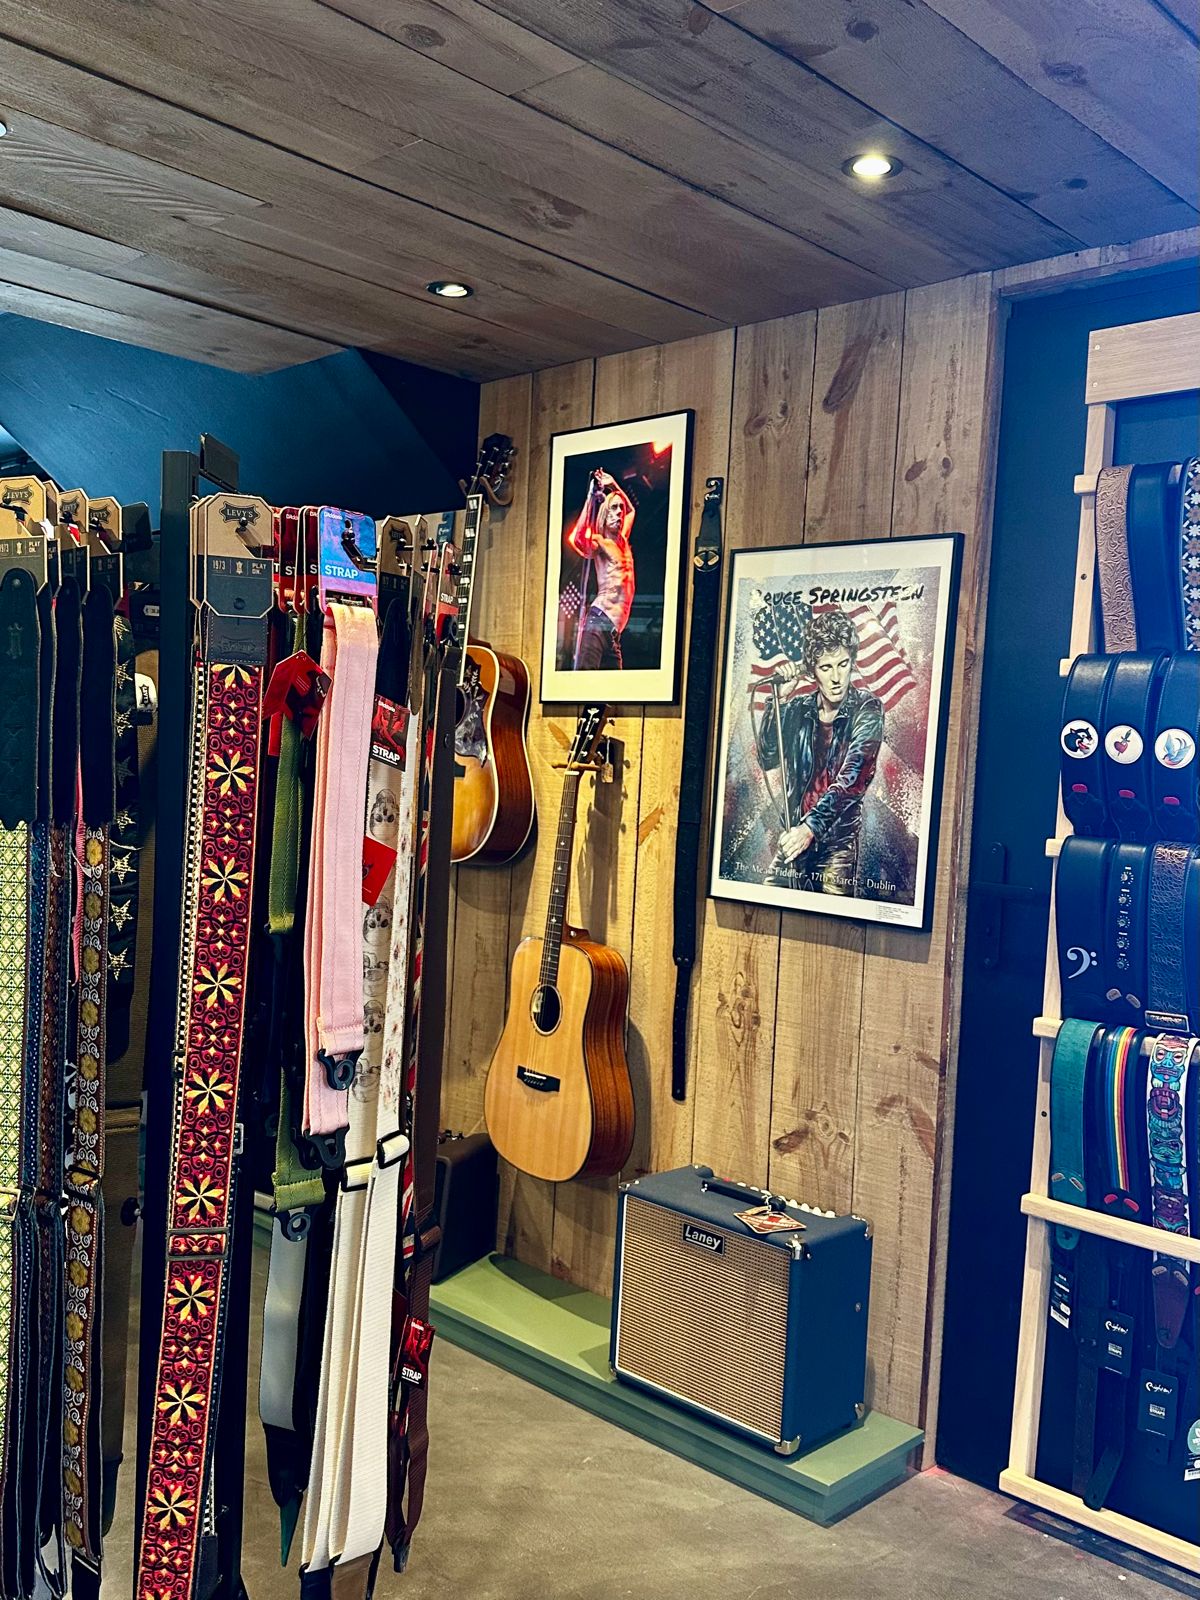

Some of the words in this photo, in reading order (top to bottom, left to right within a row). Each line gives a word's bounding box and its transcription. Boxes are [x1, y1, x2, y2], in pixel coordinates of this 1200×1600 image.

[226, 508, 254, 518] LEVY'S
[212, 560, 226, 570] 1973
[251, 562, 267, 570] PLAY
[324, 564, 359, 579] STRAP
[440, 592, 454, 604] STRAP
[756, 589, 803, 606] RUCE
[372, 744, 401, 762] STRAP
[735, 861, 750, 871] The
[811, 871, 828, 882] 17th
[866, 878, 896, 891] Dublin
[685, 1225, 721, 1249] Laney
[401, 1366, 422, 1381] STRAP
